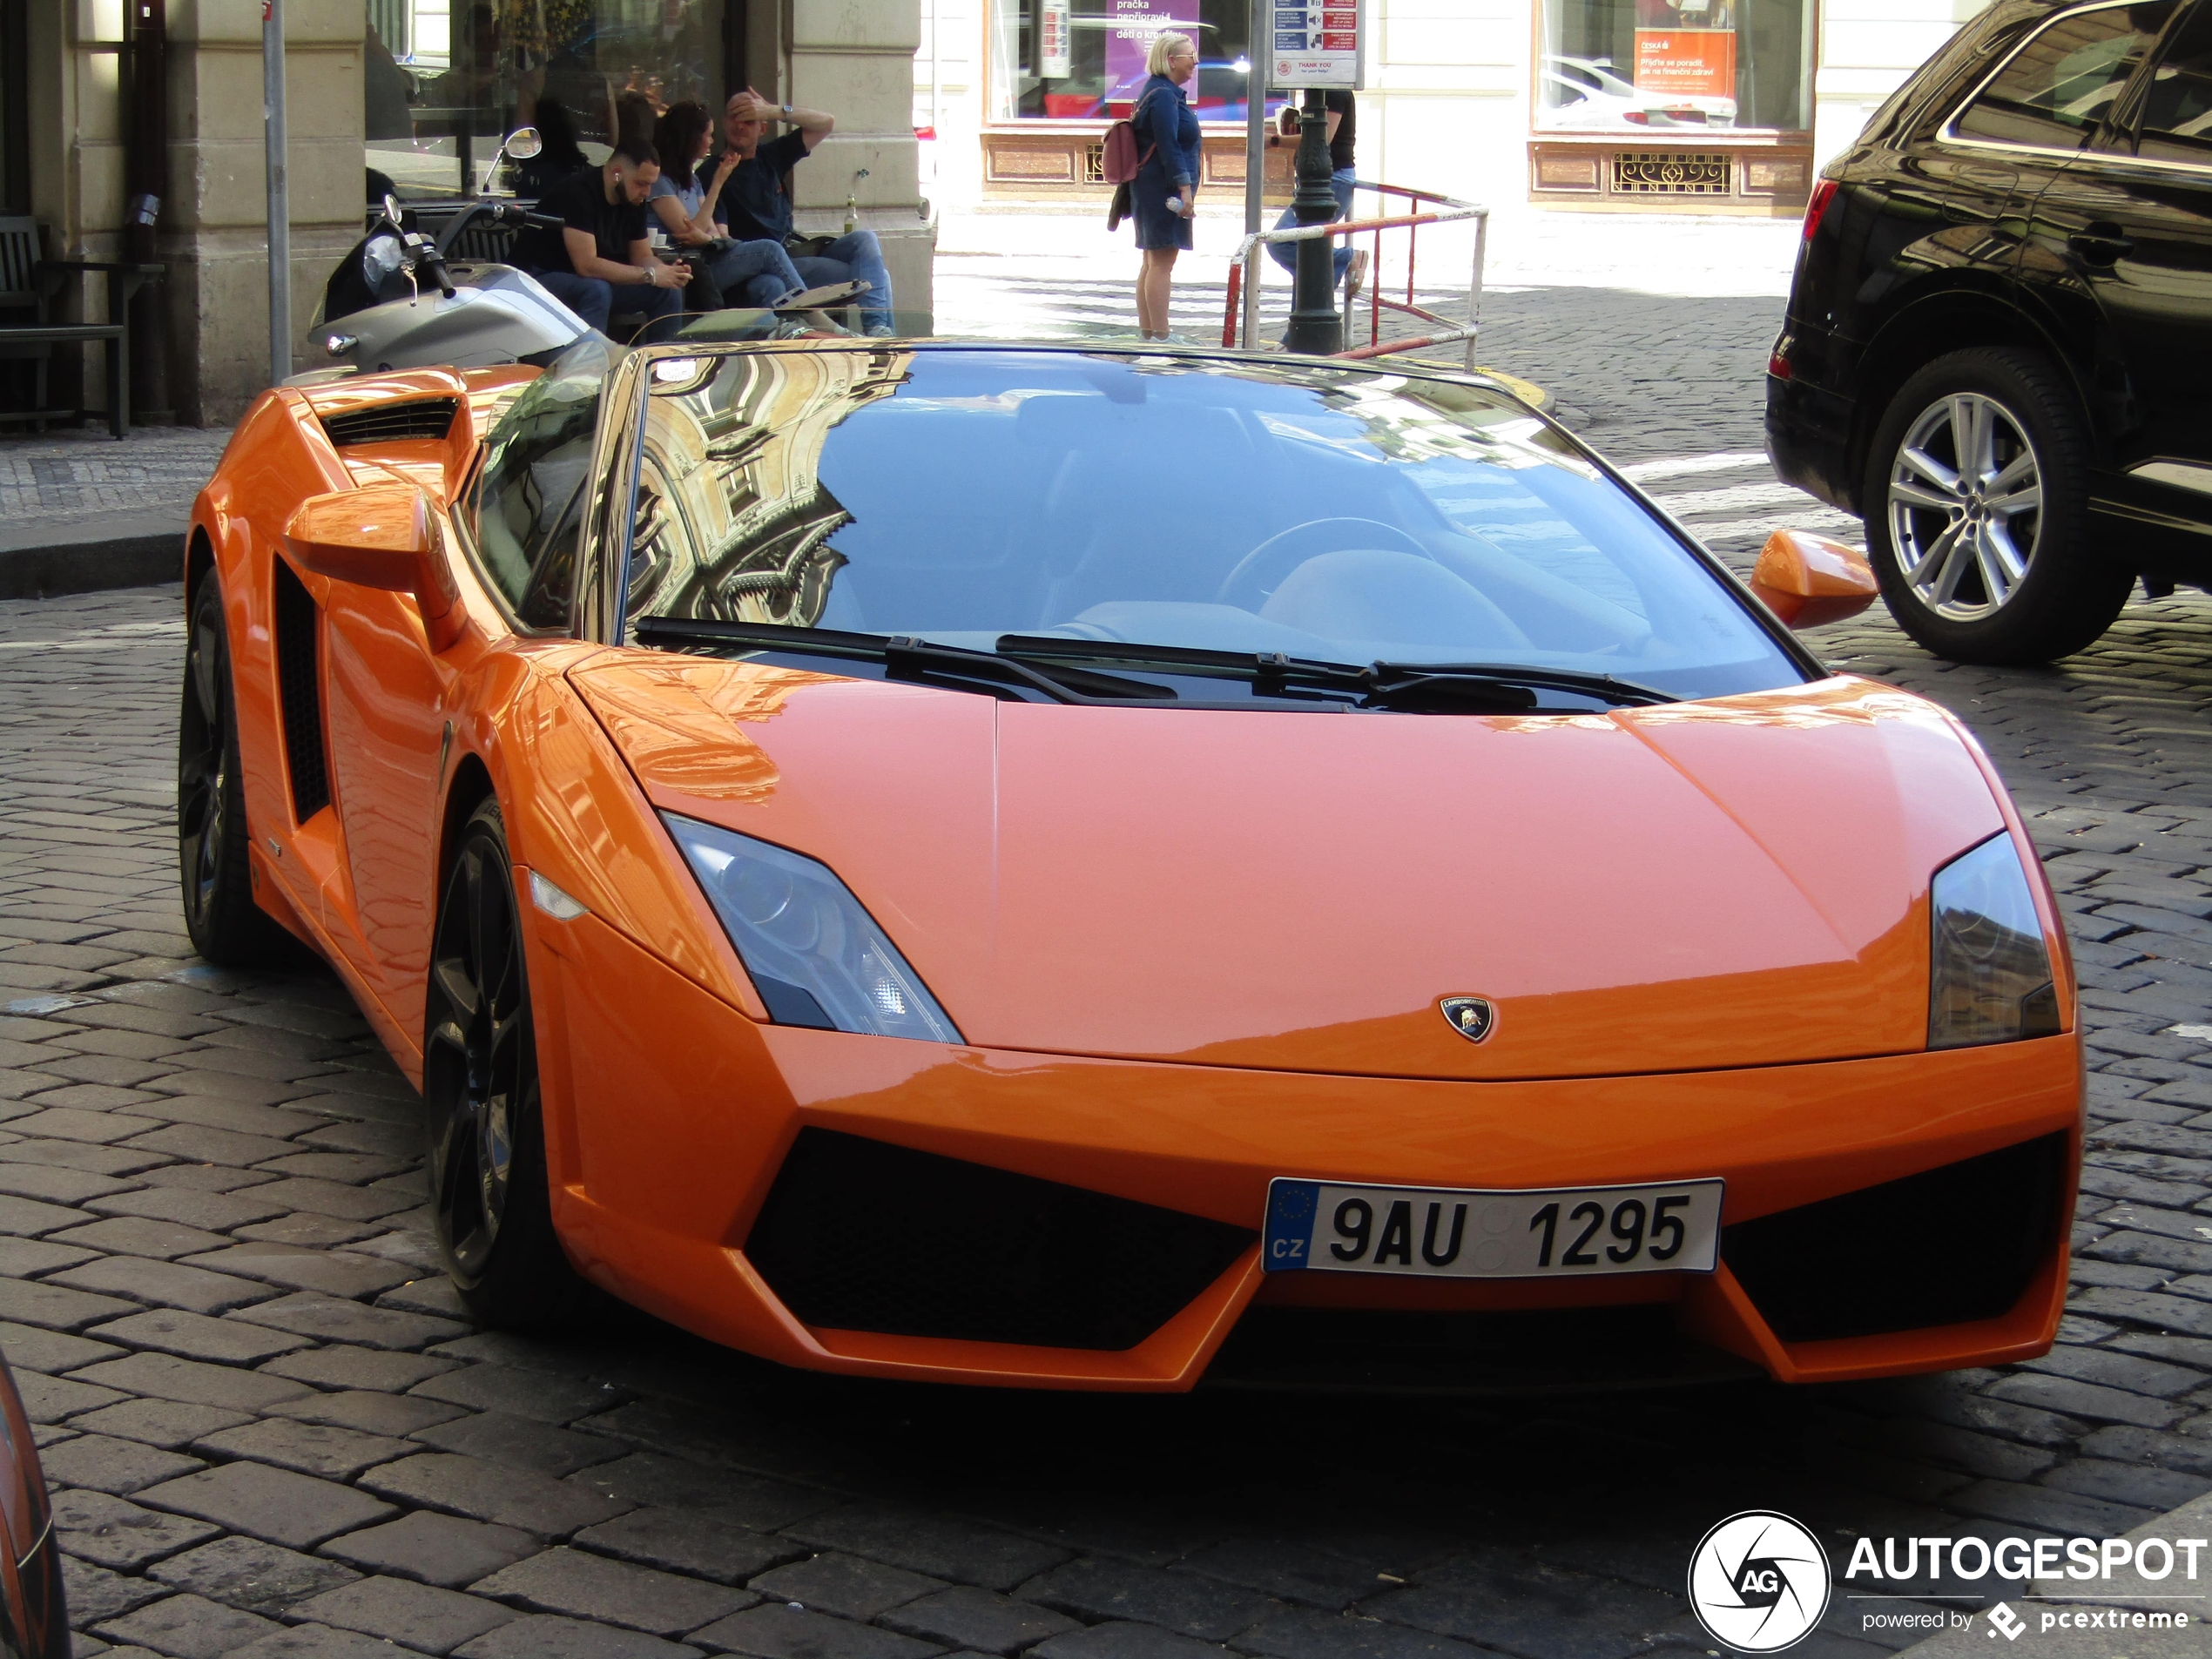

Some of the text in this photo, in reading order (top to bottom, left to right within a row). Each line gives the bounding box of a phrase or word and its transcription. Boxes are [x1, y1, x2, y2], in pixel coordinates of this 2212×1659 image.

[1116, 0, 1150, 10] pračka
[1116, 30, 1135, 39] děti
[1640, 58, 1664, 67] Přijďte
[1329, 1195, 1690, 1268] 9AU 1295
[1272, 1238, 1303, 1259] CZ
